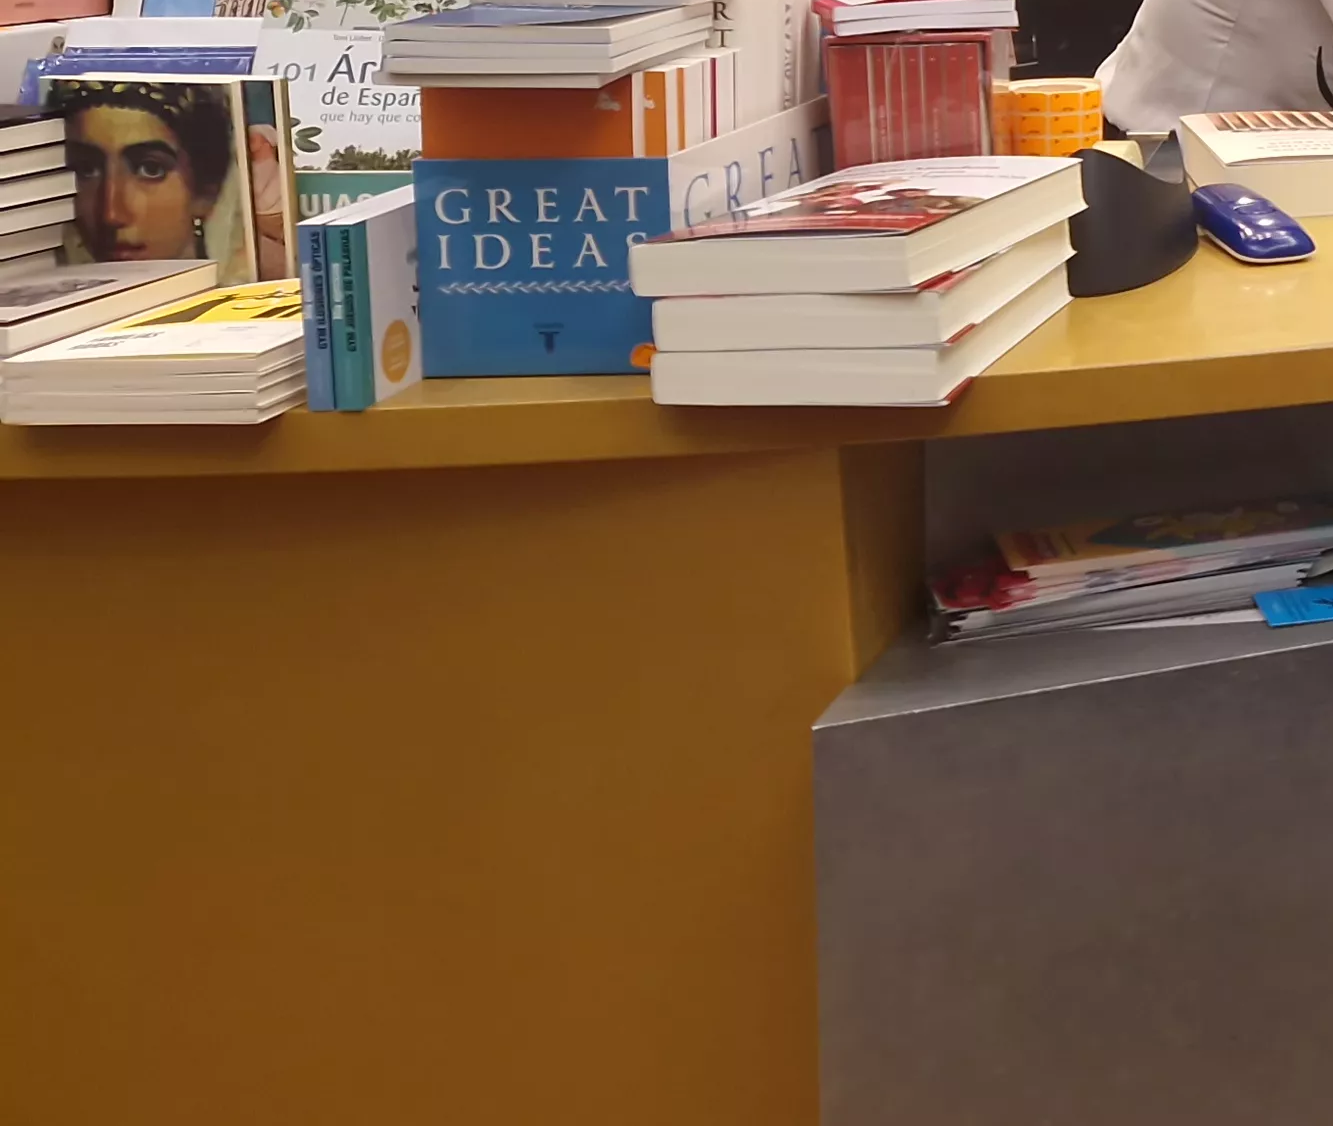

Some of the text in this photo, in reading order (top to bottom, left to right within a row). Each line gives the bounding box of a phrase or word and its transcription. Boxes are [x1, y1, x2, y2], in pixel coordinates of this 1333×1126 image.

[266, 62, 318, 83] 101
[321, 87, 351, 107] de
[320, 110, 402, 126] que hay que
[434, 185, 649, 226] GREAT
